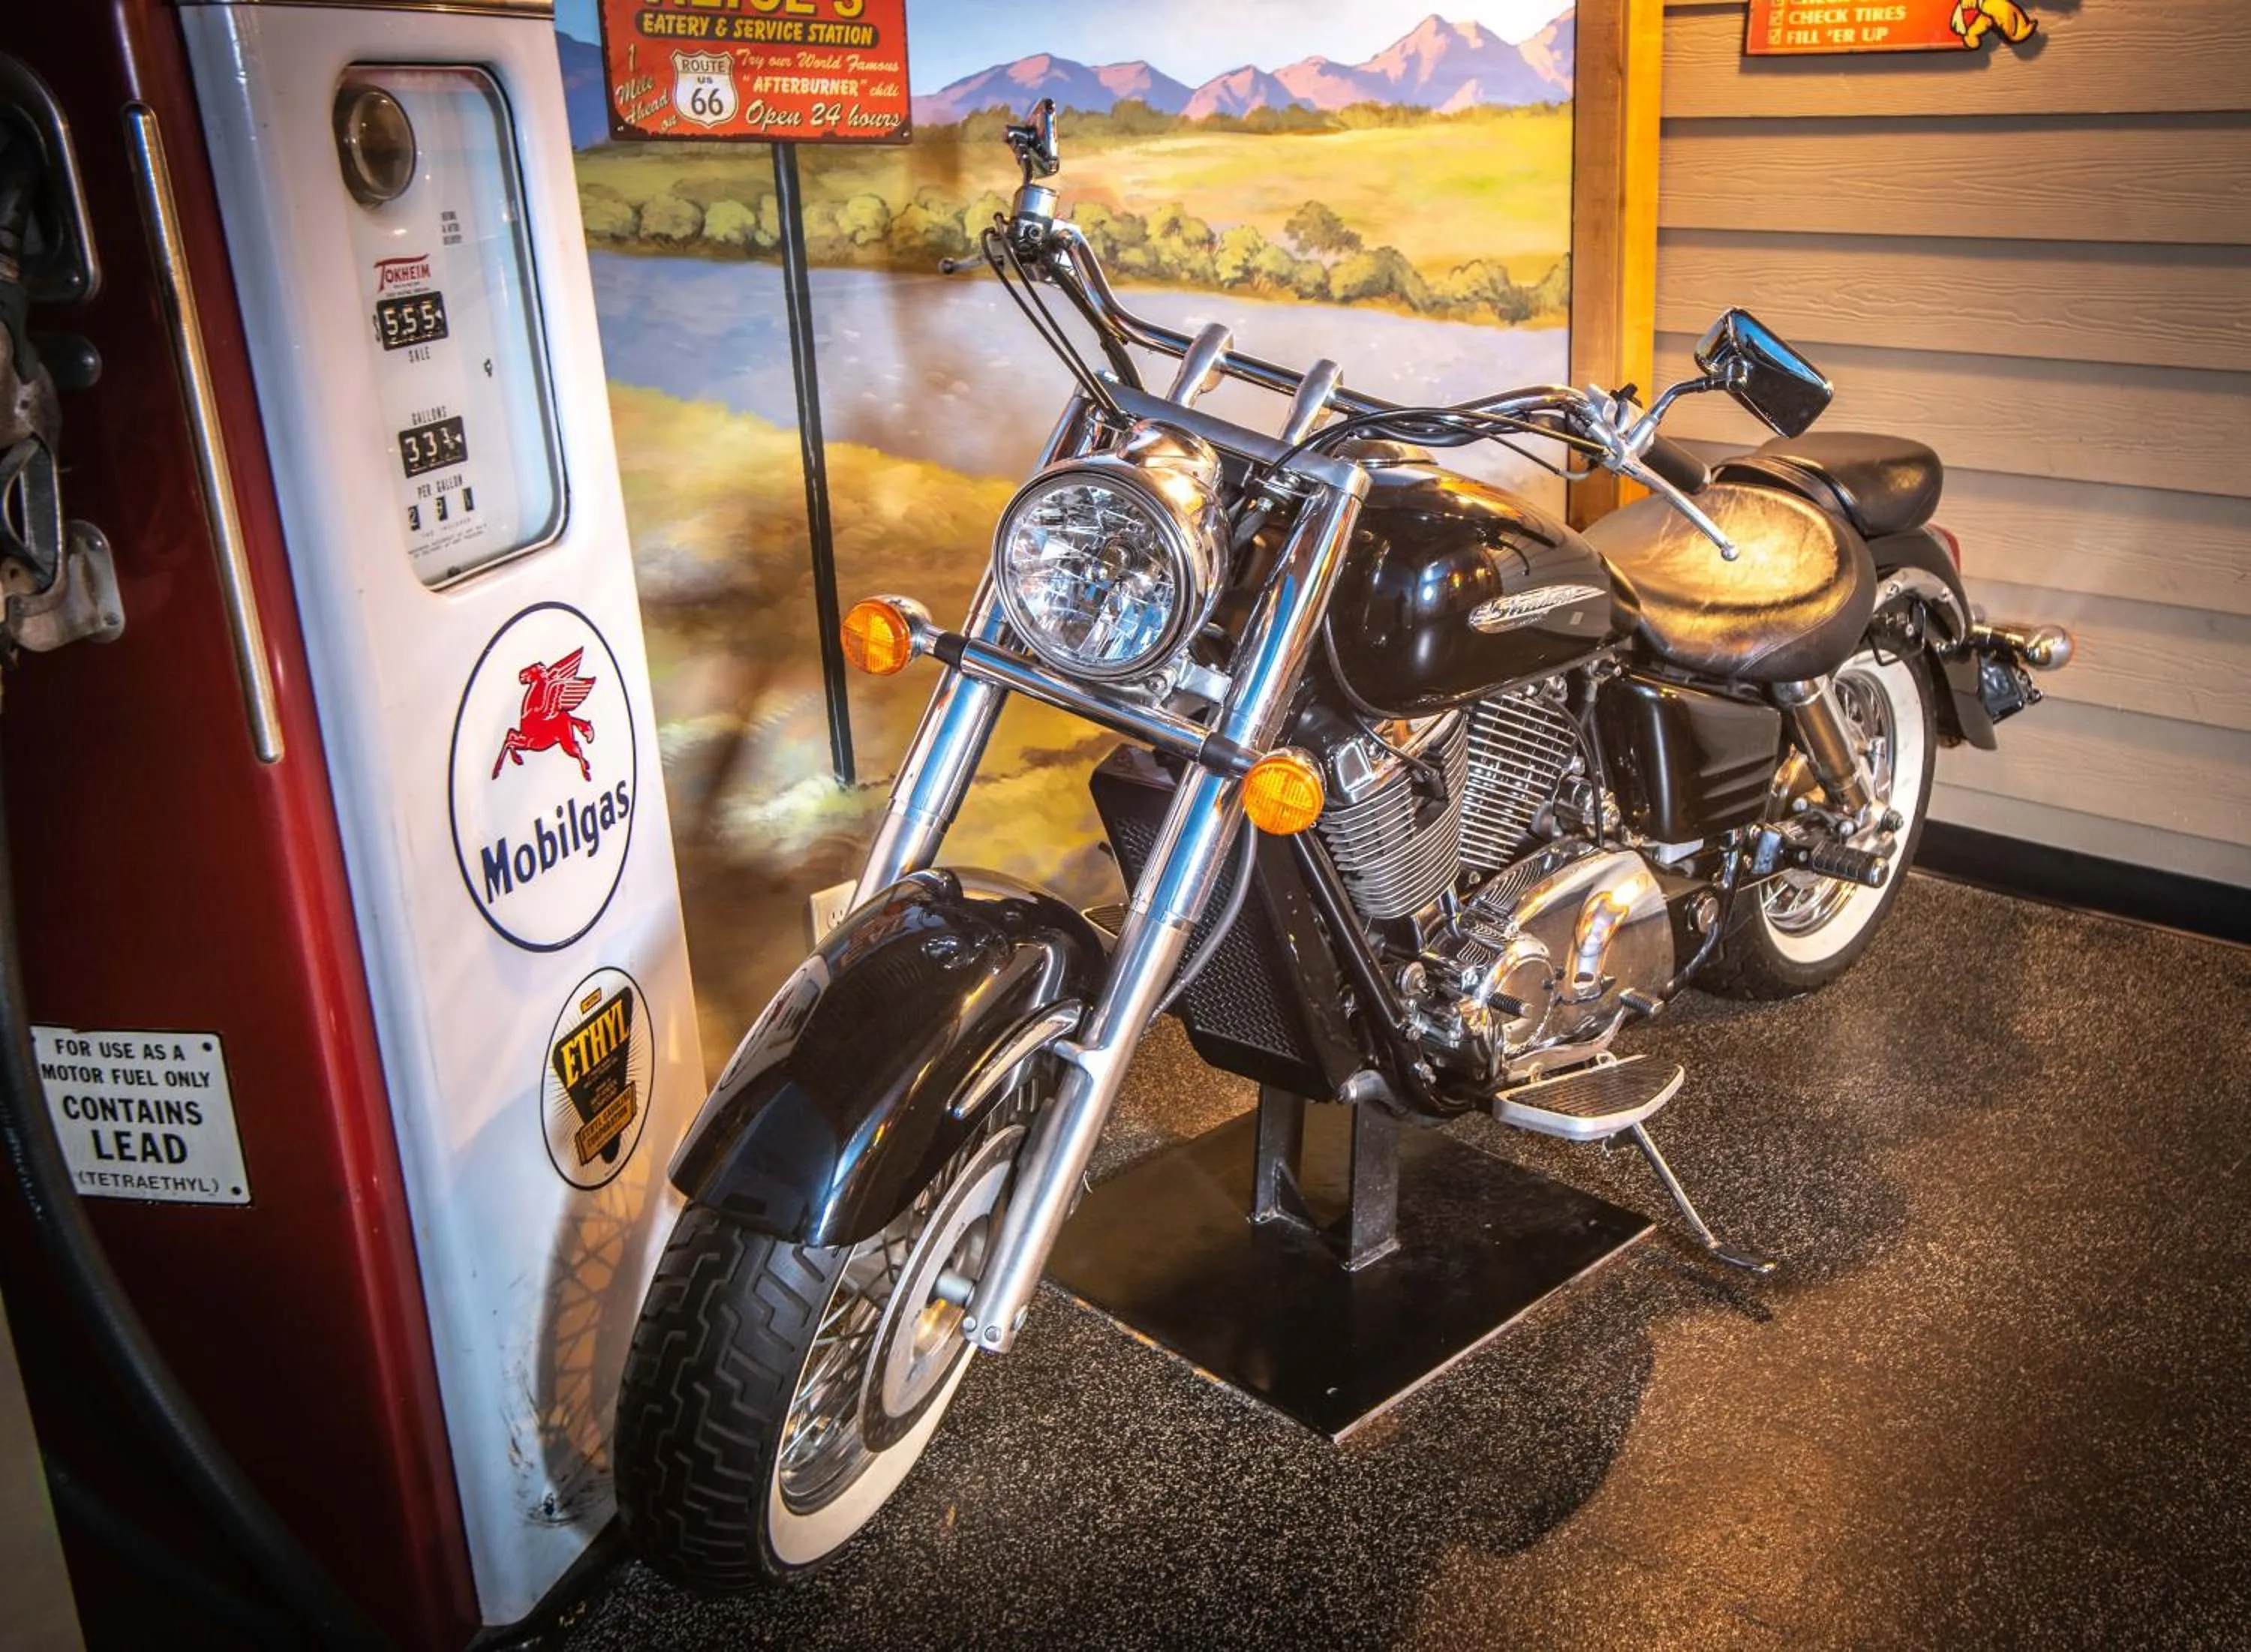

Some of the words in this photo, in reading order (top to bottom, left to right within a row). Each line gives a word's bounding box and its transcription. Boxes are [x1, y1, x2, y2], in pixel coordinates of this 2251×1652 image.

[1789, 8, 1849, 24] CHECK
[1854, 5, 1907, 23] TIRES
[642, 13, 711, 37] EATERY
[715, 17, 729, 36] &
[733, 18, 803, 41] SERVICE
[807, 23, 873, 46] STATION
[1786, 29, 1820, 45] FILL
[1827, 28, 1855, 44] 'ER
[1862, 26, 1889, 42] UP
[681, 59, 726, 73] ROUTE
[736, 48, 765, 69] Try
[768, 56, 792, 68] our
[797, 52, 843, 70] World
[846, 54, 900, 73] Famous
[615, 76, 655, 105] Mile
[697, 76, 714, 85] US
[624, 87, 669, 125] Ahead
[691, 88, 723, 116] 66
[745, 99, 801, 132] Open
[810, 101, 841, 126] 24
[846, 103, 901, 128] hours
[374, 253, 431, 293] TOKHEIM
[408, 346, 430, 364] SALE
[411, 406, 446, 425] GALLONS
[417, 483, 432, 500] PER
[436, 474, 463, 493] GALLON
[480, 780, 630, 904] Mobilgas
[55, 1038, 92, 1057] FOR
[98, 1042, 135, 1059] USE
[143, 1044, 167, 1060] AS
[173, 1045, 185, 1061] A
[561, 999, 630, 1089] ETHYL
[41, 1064, 104, 1083] MOTOR
[113, 1069, 158, 1086] FUEL
[165, 1071, 210, 1088] ONLY
[63, 1095, 203, 1125] CONTAINS
[92, 1129, 188, 1164] LEAD
[78, 1170, 220, 1193] (TETRAETHYL)
